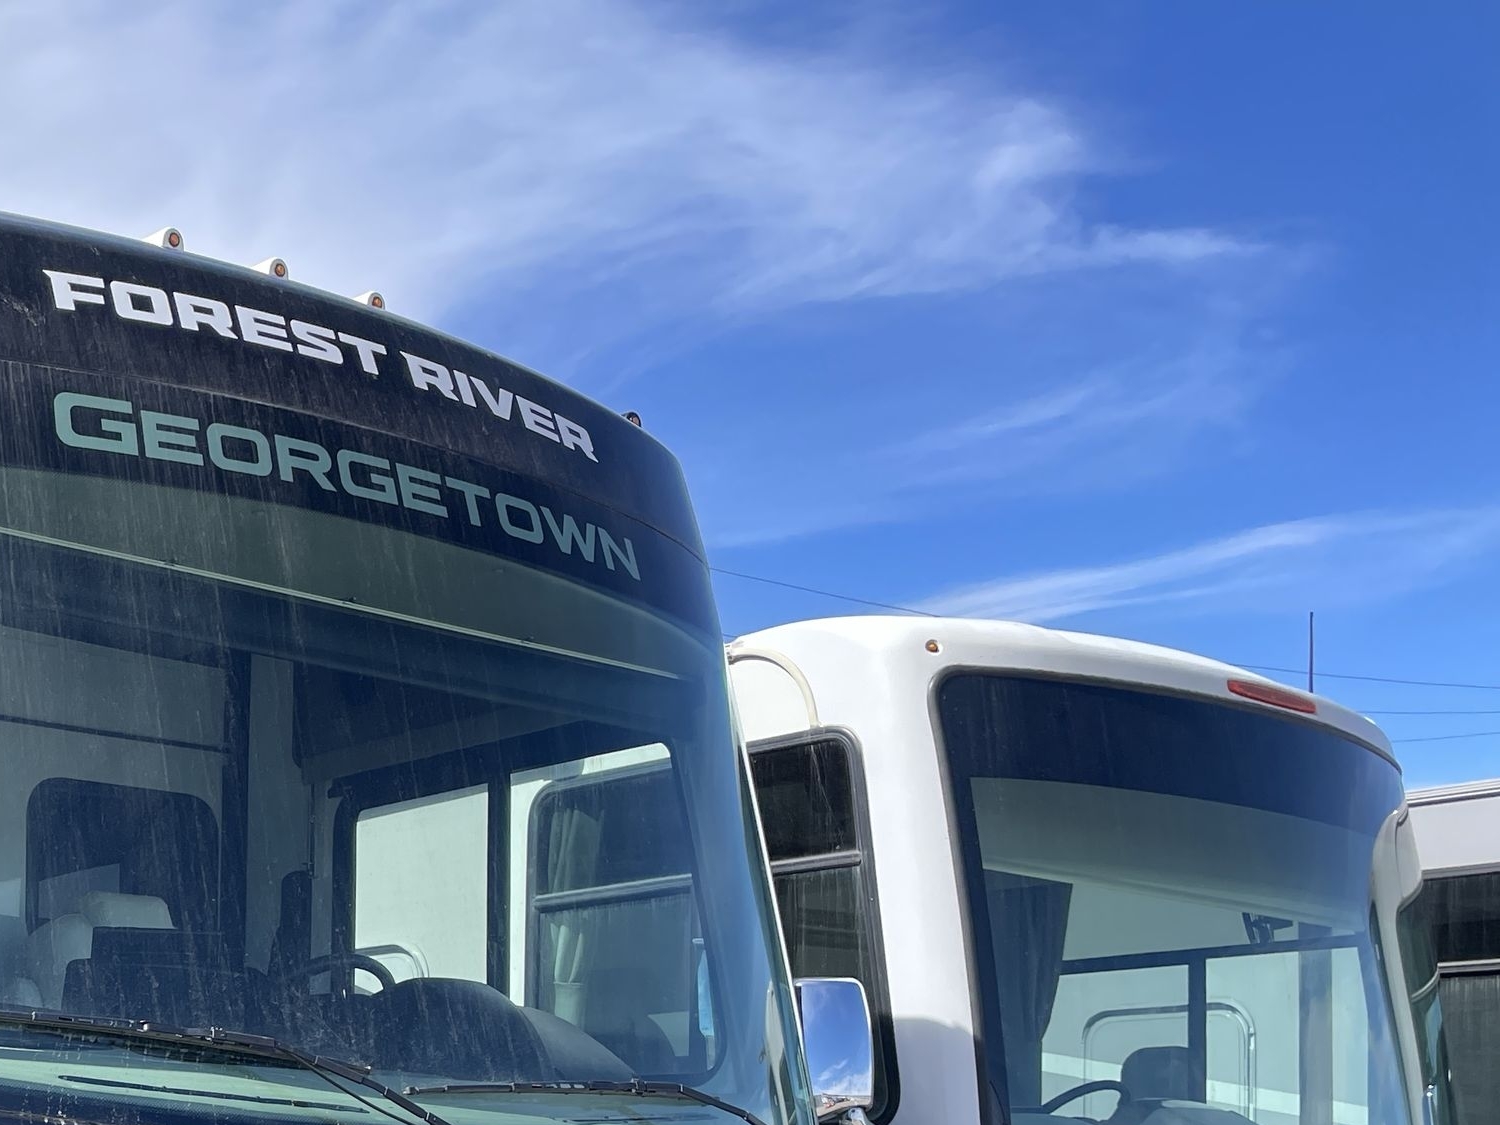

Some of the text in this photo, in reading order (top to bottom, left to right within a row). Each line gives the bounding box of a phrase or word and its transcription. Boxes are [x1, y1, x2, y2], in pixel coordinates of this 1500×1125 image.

[43, 269, 598, 463] FOREST RIVER
[53, 391, 642, 581] GEORGETOWN
